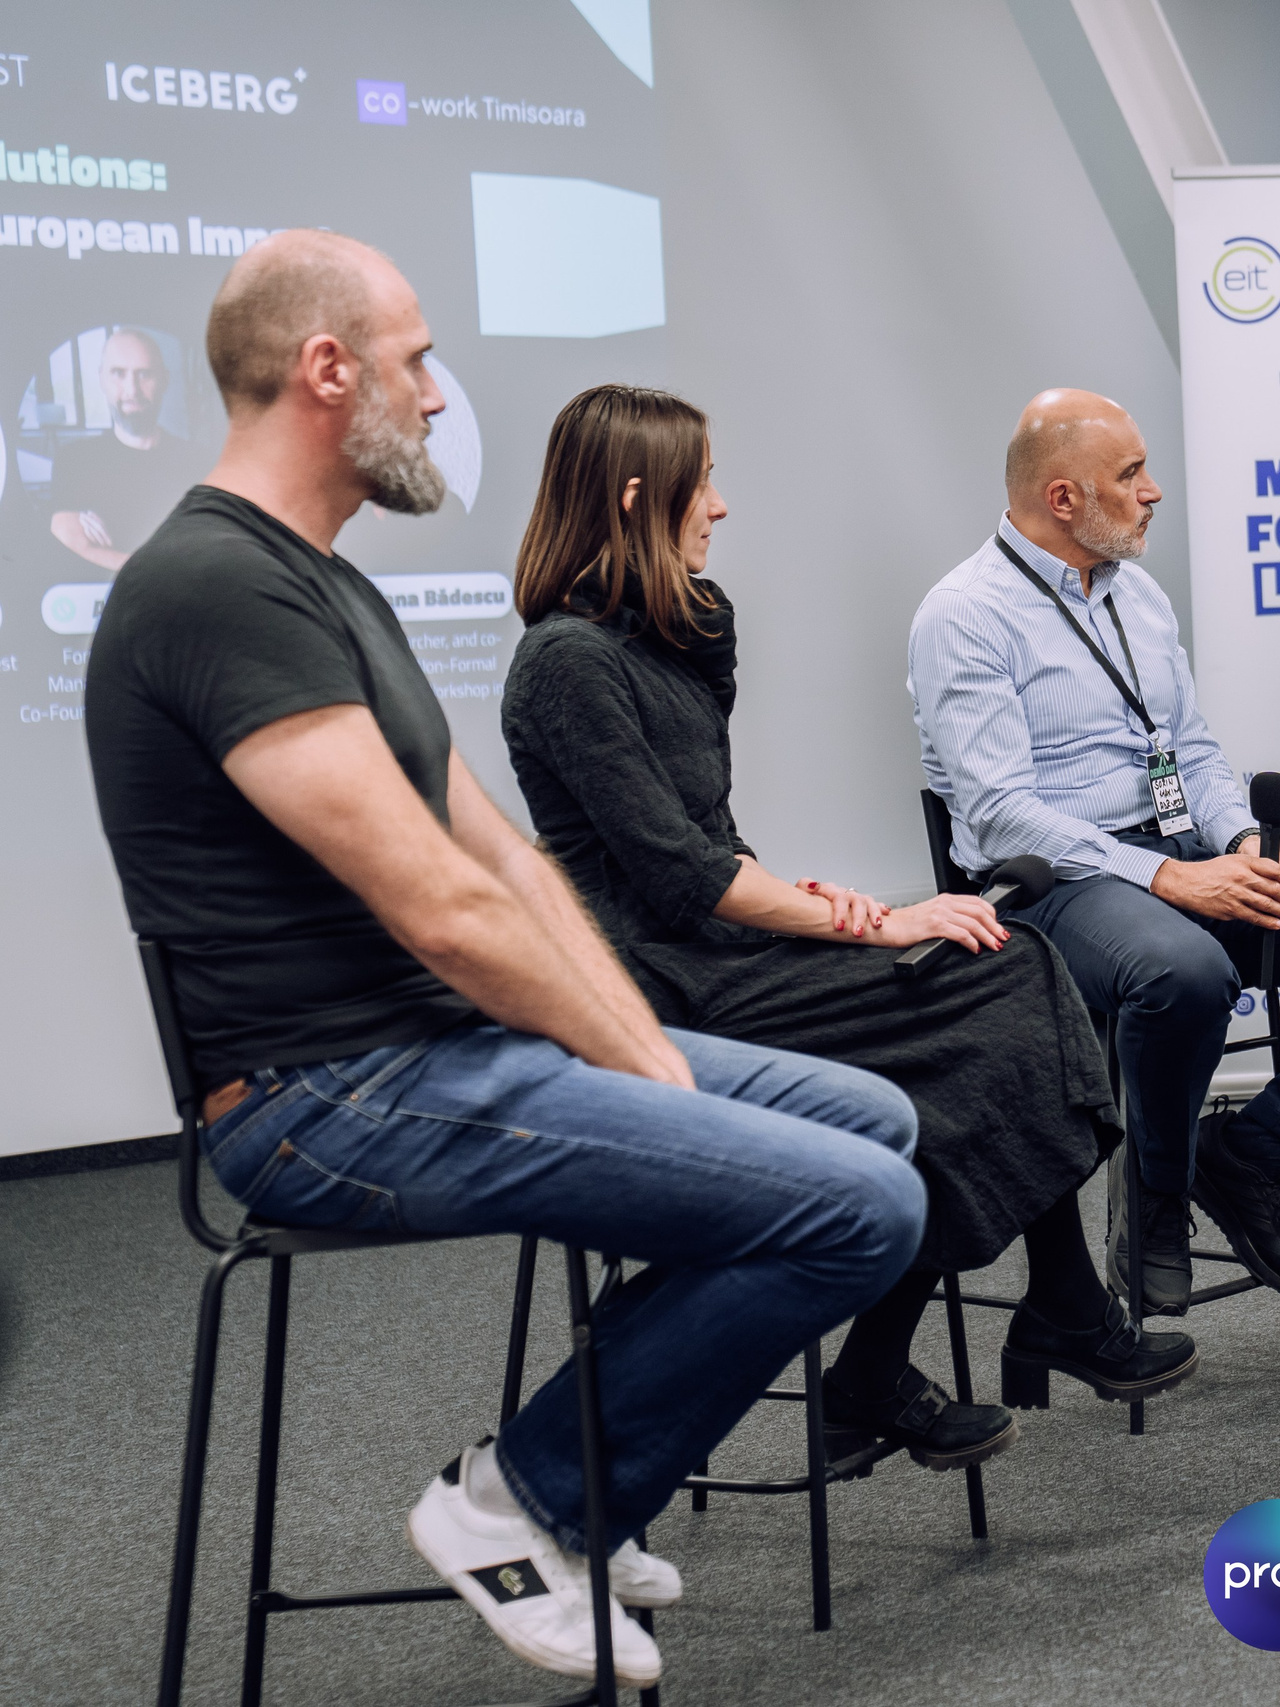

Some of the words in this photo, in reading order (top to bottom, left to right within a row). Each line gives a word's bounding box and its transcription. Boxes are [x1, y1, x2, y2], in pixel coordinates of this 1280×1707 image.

[481, 96, 586, 127] Timisoara
[1223, 265, 1268, 291] eit
[451, 632, 477, 648] and
